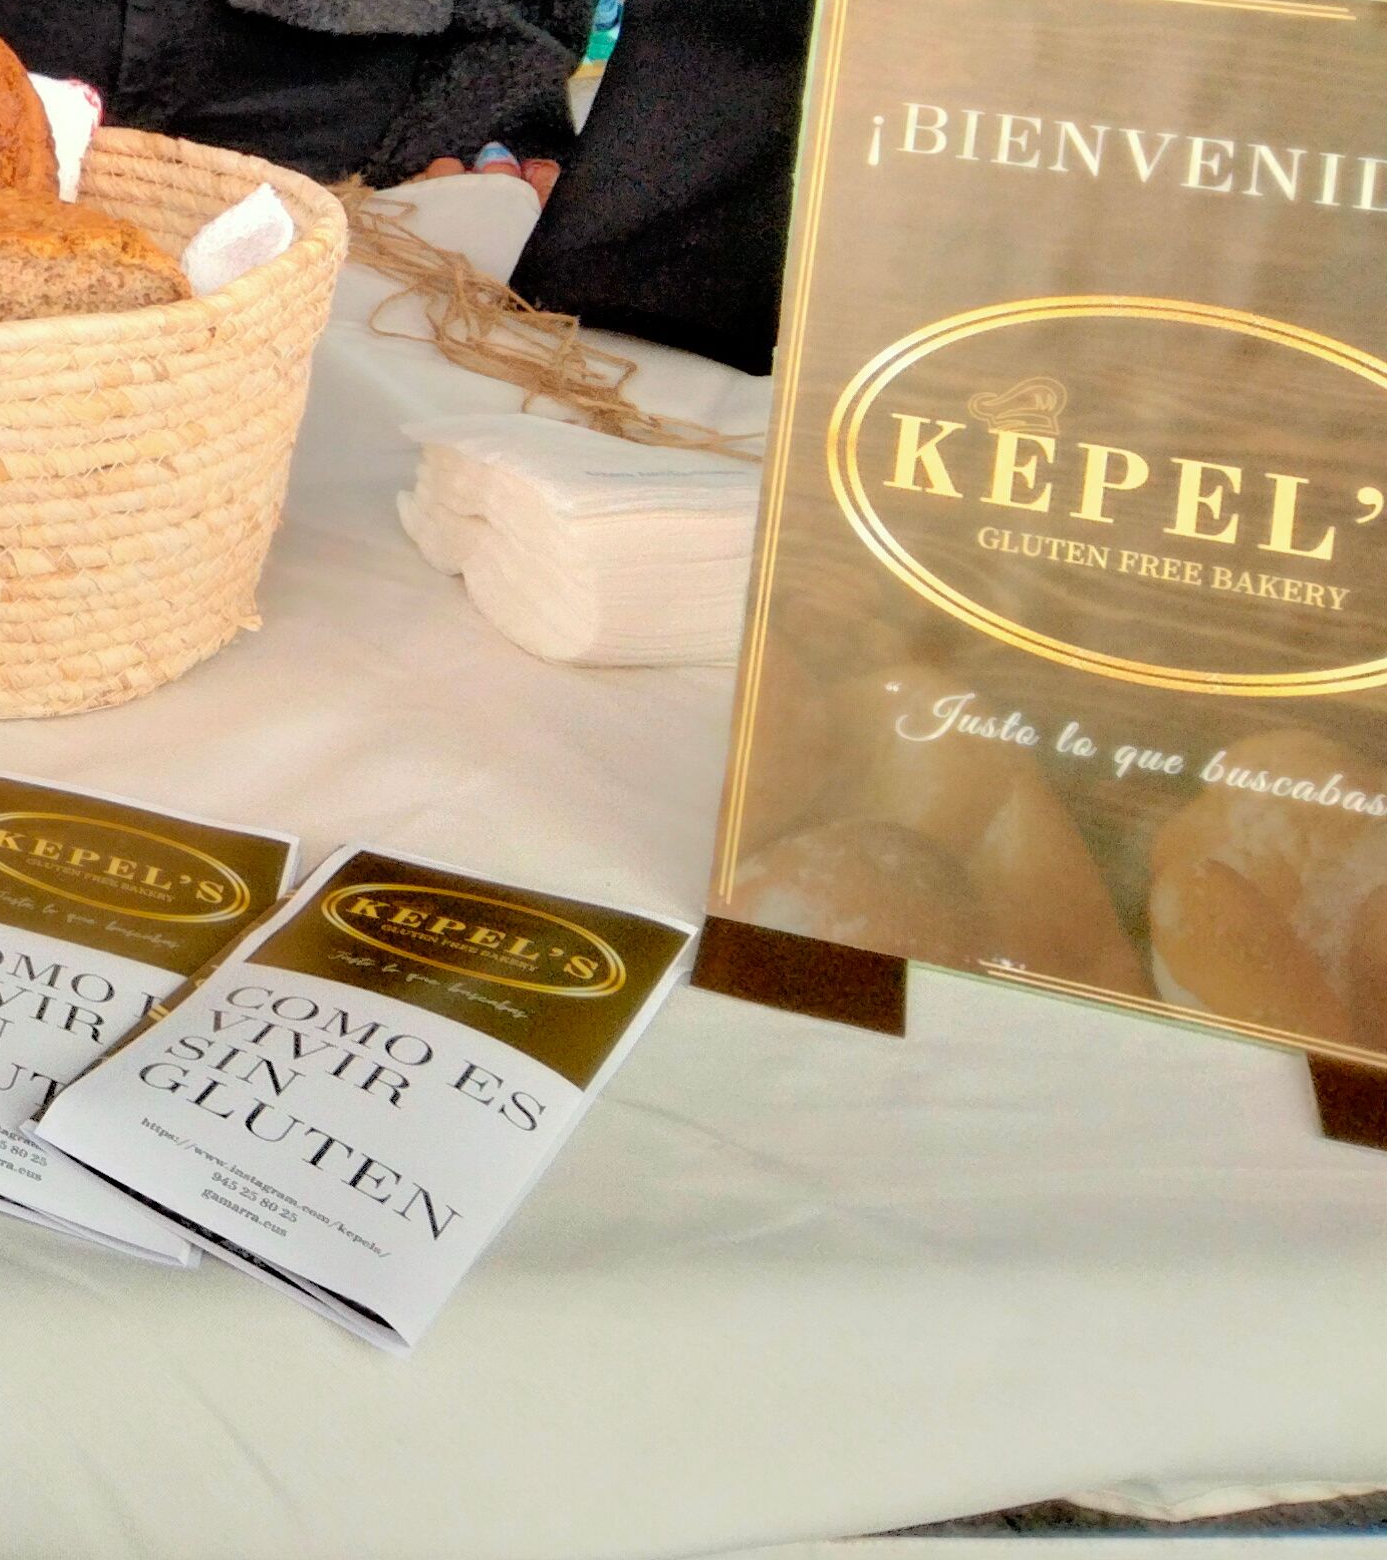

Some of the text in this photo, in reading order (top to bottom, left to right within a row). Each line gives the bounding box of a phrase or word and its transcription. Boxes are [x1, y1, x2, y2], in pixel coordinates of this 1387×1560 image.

[977, 526, 1352, 611] GLUTEN FREE BAKERY
[1056, 721, 1098, 759] lo
[1114, 743, 1186, 779] que
[345, 896, 599, 980] KEPEL'S
[164, 1035, 307, 1097] SIN
[207, 1009, 412, 1111] VIVIR
[226, 985, 548, 1134] COMO ES
[9, 1143, 29, 1160] 80
[30, 1151, 48, 1167] 25
[137, 1061, 465, 1242] GLUTEN
[200, 1187, 288, 1239] gamarra.eus
[211, 1170, 299, 1224] 945 25 80 25
